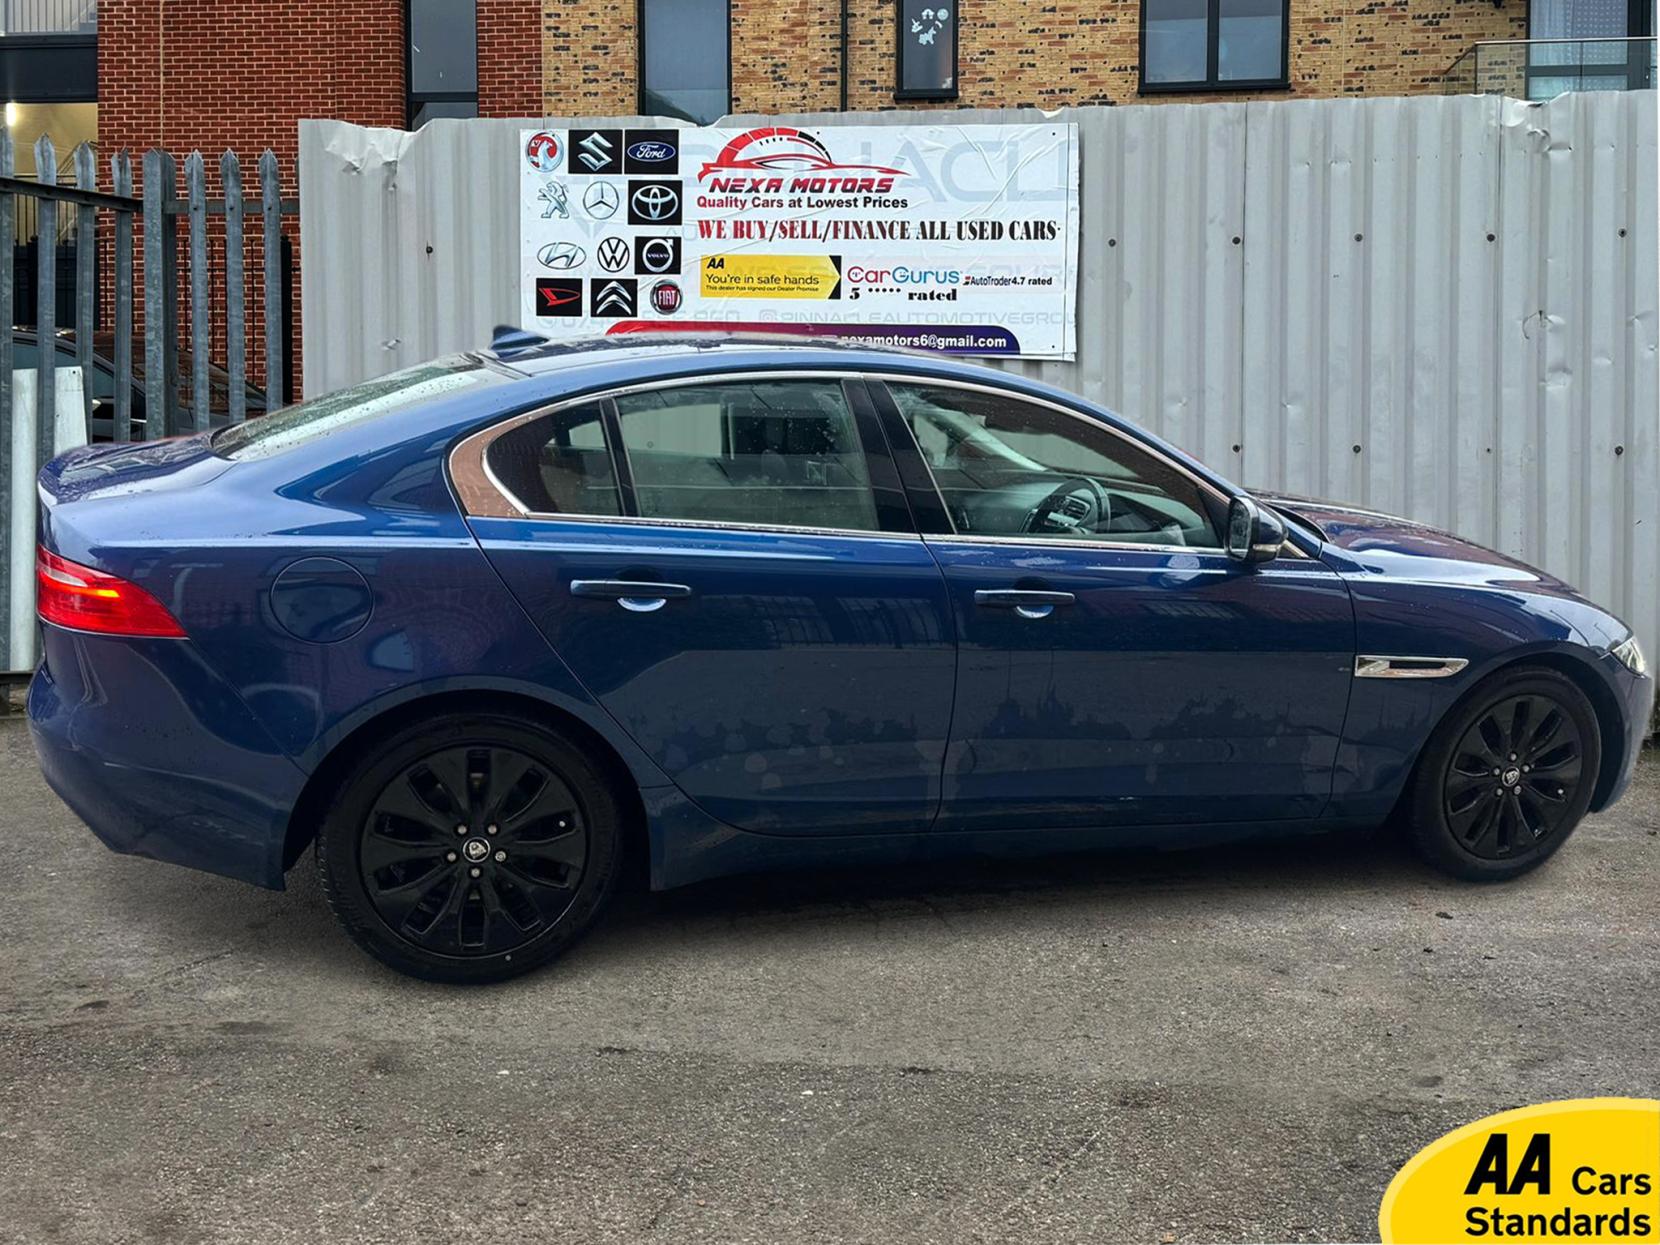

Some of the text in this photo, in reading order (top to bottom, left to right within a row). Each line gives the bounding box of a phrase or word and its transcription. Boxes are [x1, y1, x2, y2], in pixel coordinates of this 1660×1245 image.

[636, 144, 666, 158] Ford
[709, 178, 894, 193] NEXA MOTORS
[697, 196, 908, 210] Quality Cars at Lowest Prices
[697, 220, 726, 239] WE
[733, 220, 910, 242] BUY/SELL/FINANCE
[916, 220, 950, 240] ALL
[956, 220, 1003, 240] USED
[1009, 220, 1056, 240] CARS
[706, 257, 725, 269] AA
[706, 274, 819, 285] You're in safe hands
[847, 266, 960, 283] CarGurus
[1011, 277, 1026, 285] 4.7
[1028, 277, 1052, 285] rated
[658, 290, 676, 305] FIAT
[849, 287, 957, 301] 5 rated
